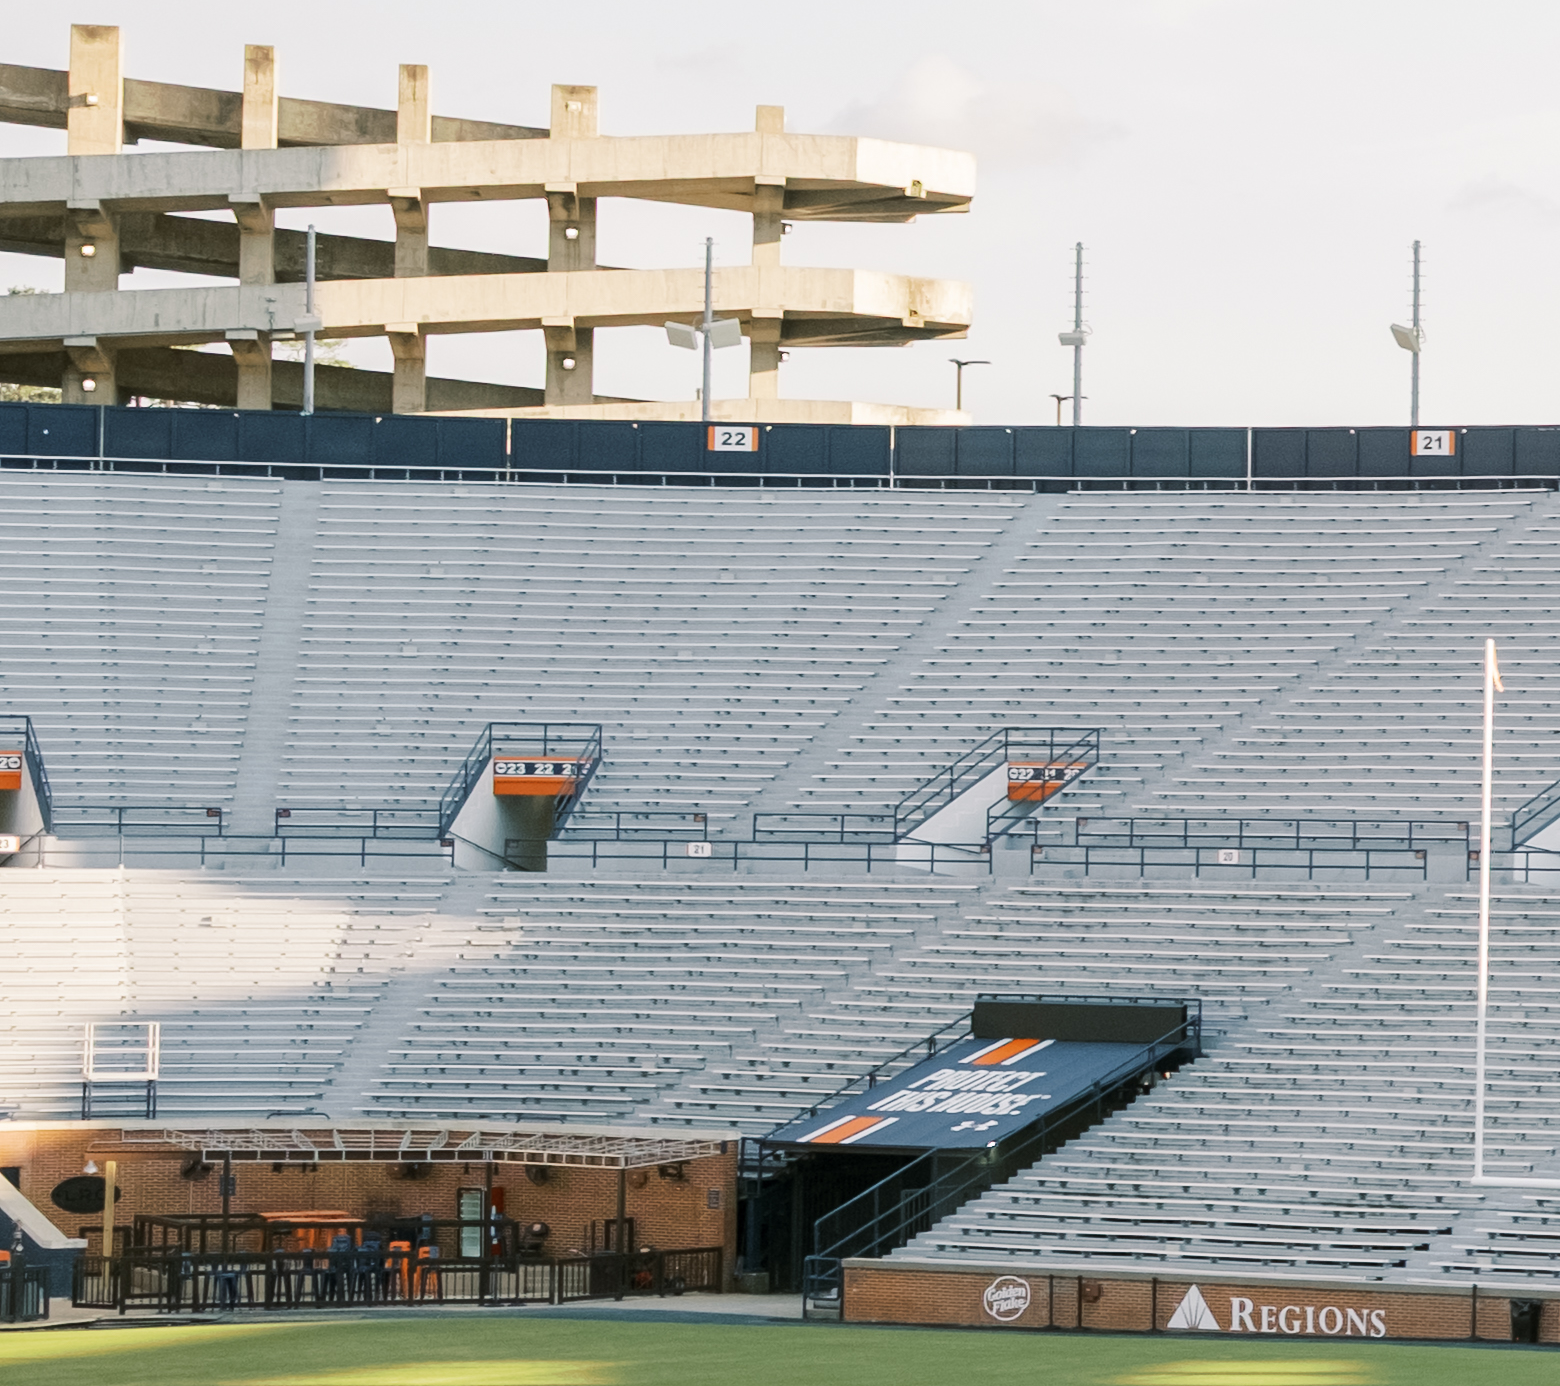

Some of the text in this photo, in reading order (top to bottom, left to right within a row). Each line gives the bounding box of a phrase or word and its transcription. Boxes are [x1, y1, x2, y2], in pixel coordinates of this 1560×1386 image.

[721, 432, 746, 446] 22
[1423, 436, 1442, 449] 21
[506, 764, 526, 774] 23
[534, 764, 554, 774] 22
[694, 844, 705, 854] 21
[906, 1069, 1047, 1092] PROTECT
[867, 1090, 952, 1113] THIS
[988, 1285, 1026, 1301] Golden
[993, 1297, 1025, 1315] Flake
[1229, 1297, 1386, 1338] REGIONS
